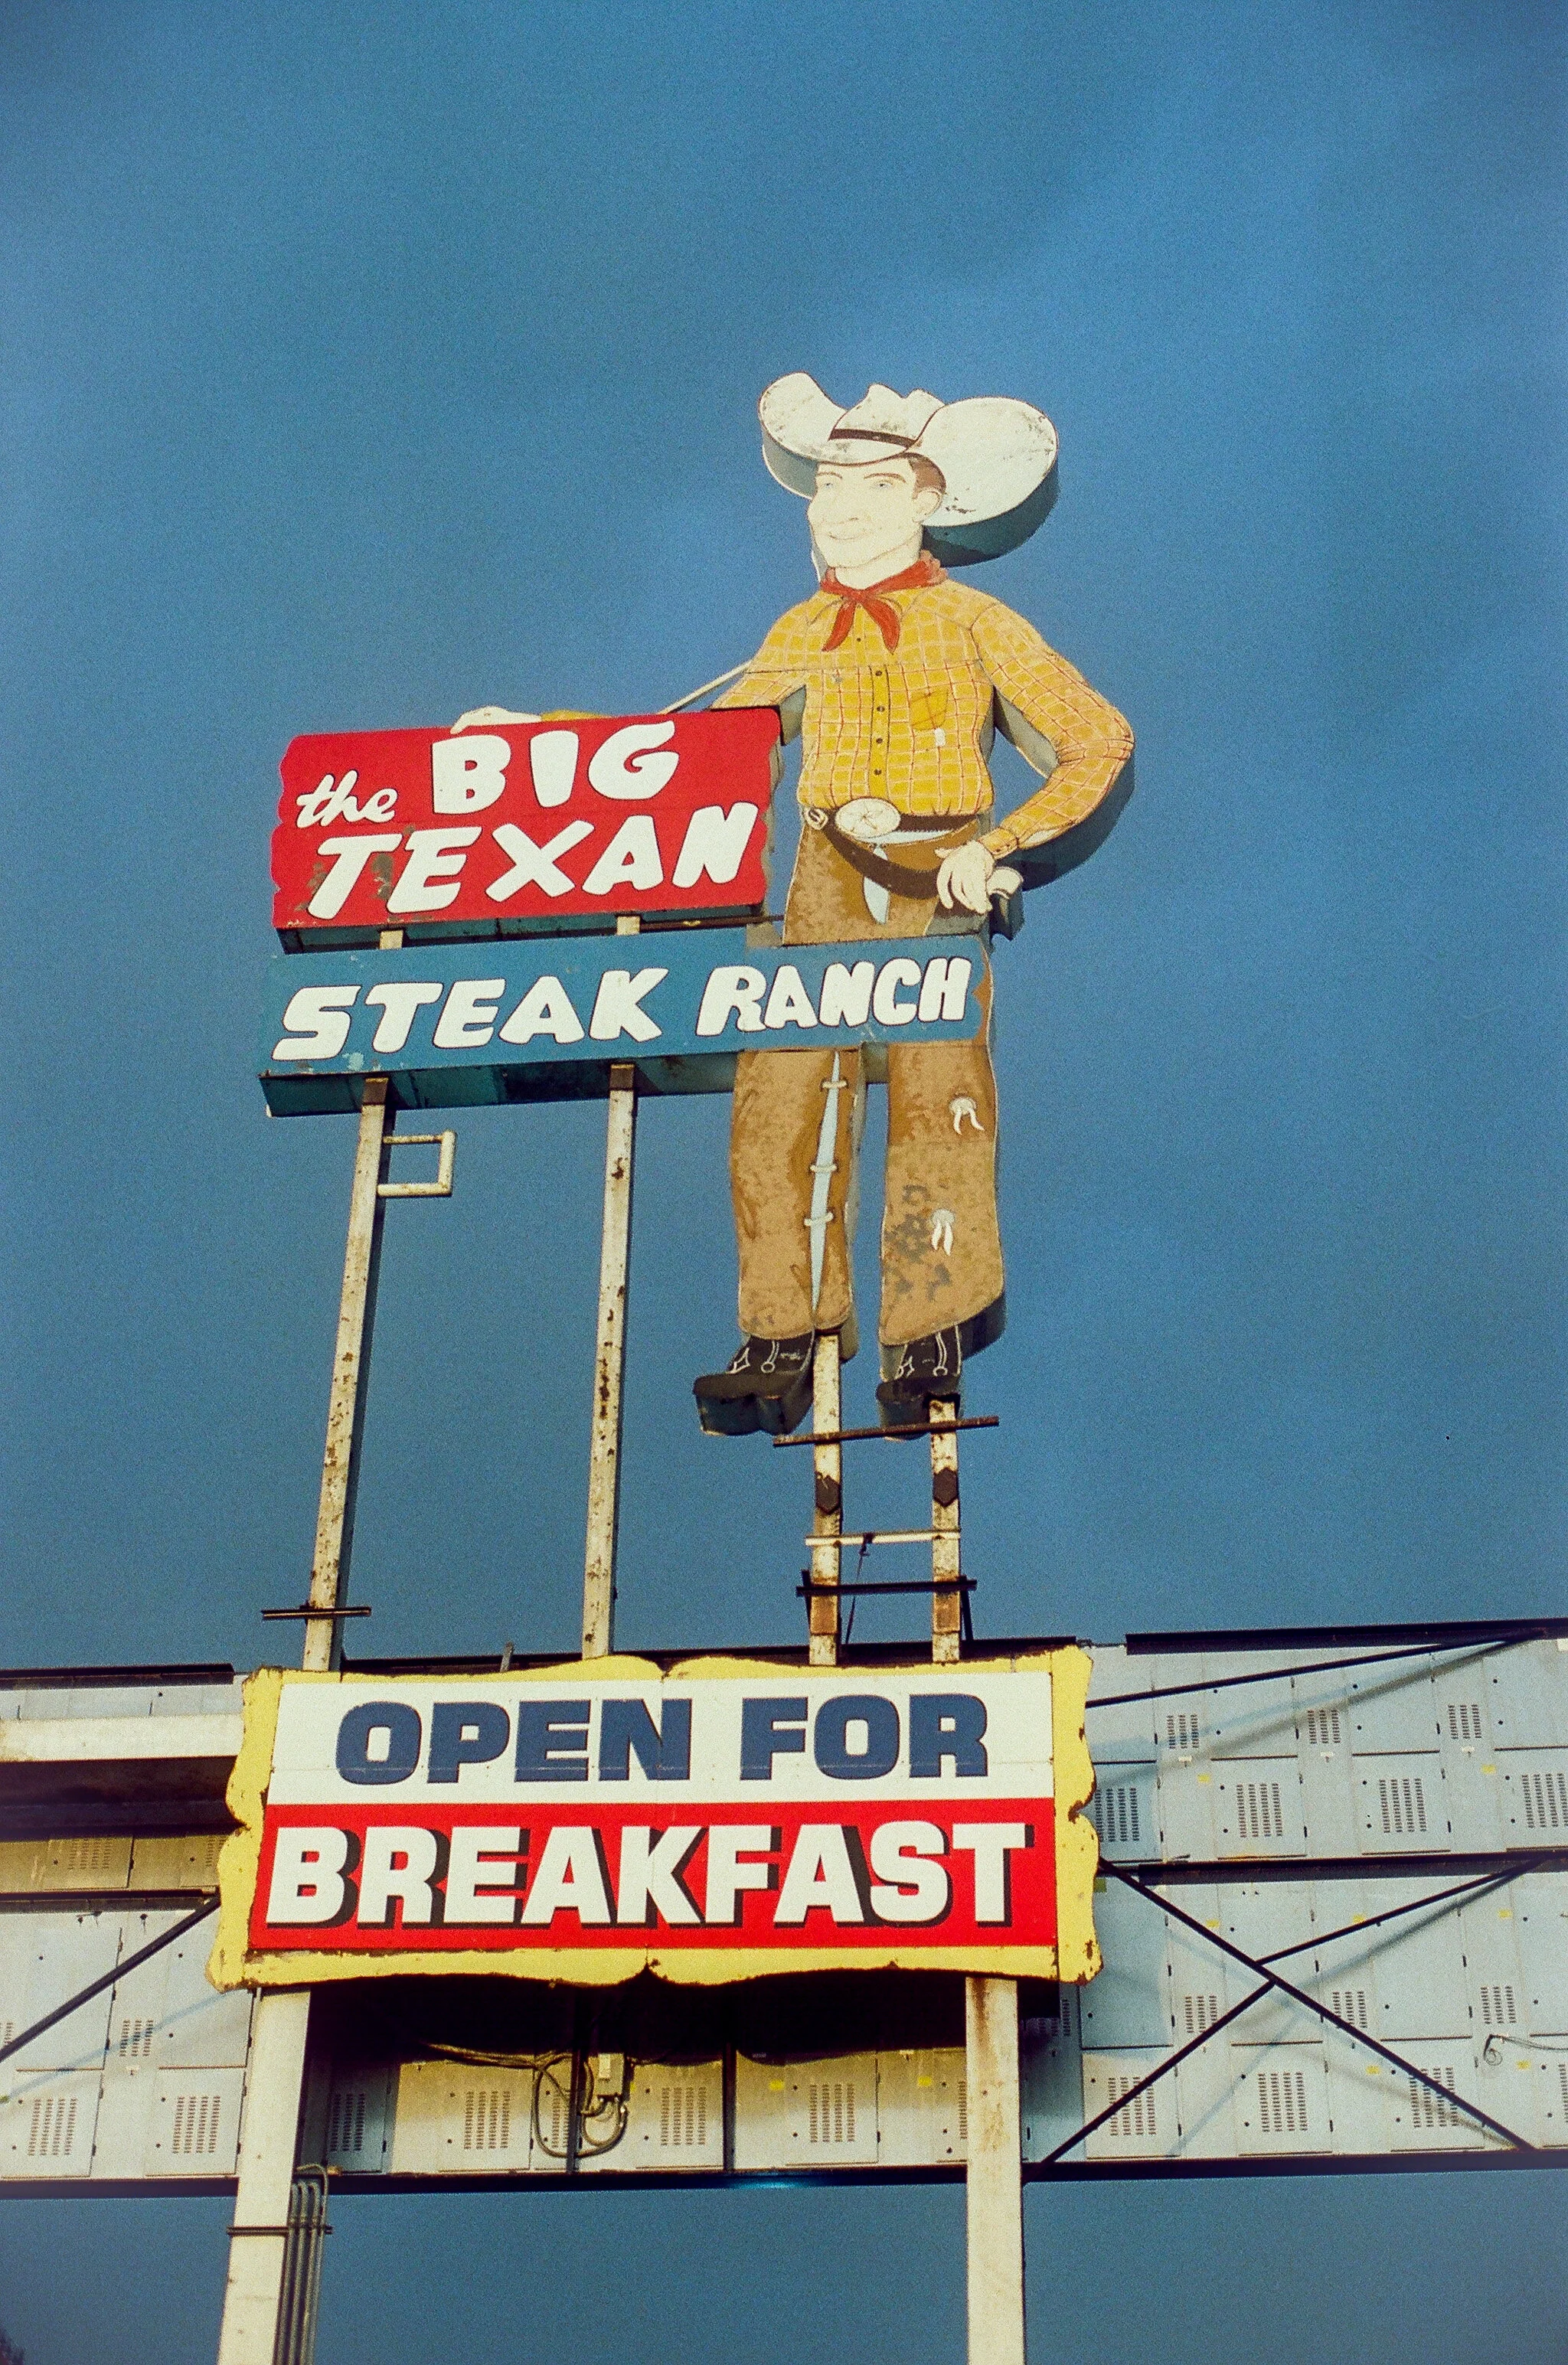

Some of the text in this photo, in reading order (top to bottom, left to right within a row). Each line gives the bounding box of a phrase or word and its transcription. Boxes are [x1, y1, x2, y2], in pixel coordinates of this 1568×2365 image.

[296, 720, 680, 829] the BIG
[308, 801, 759, 920] TEXAN
[272, 957, 973, 1062] STEAK RANCH
[335, 1693, 989, 1785] OPEN FOR
[266, 1820, 1035, 1929] BREAKFAST
